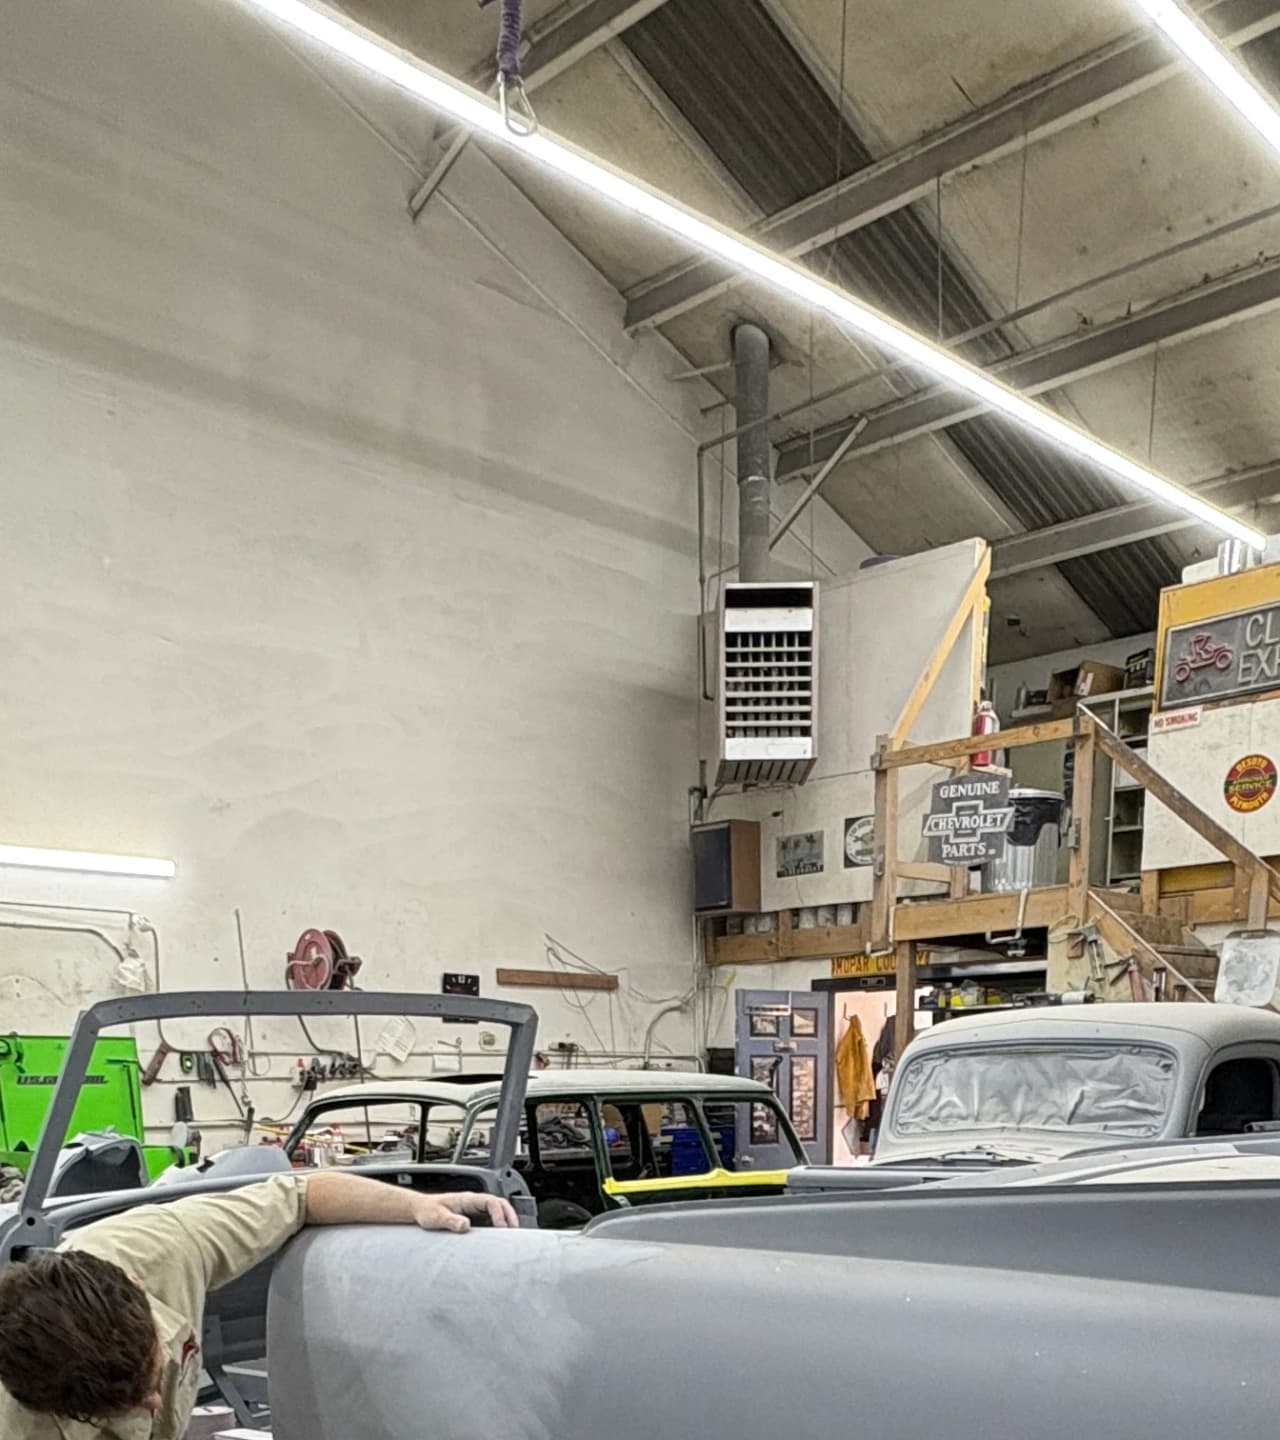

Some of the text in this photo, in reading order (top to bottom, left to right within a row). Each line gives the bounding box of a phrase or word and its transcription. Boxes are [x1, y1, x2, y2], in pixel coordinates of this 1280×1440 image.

[1165, 711, 1199, 727] SMOKING
[939, 781, 1000, 799] GENUINE
[930, 814, 1004, 831] CHEVROLET
[941, 842, 987, 858] PARTS
